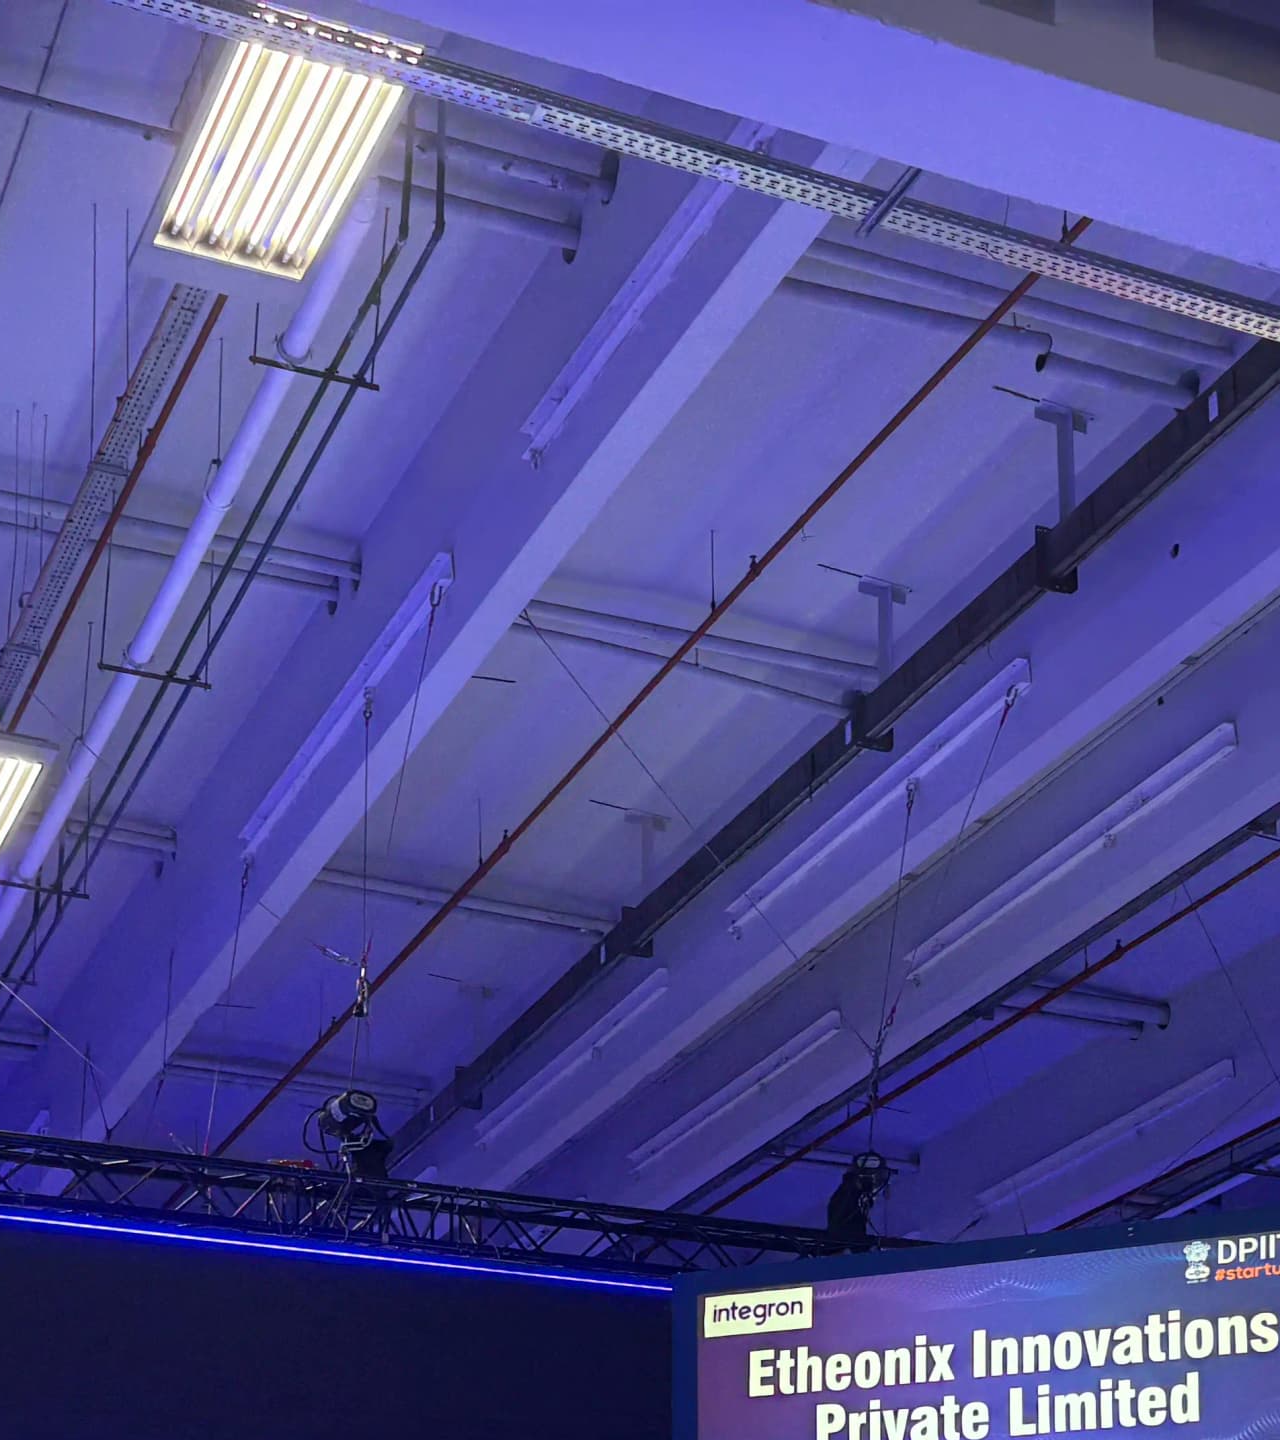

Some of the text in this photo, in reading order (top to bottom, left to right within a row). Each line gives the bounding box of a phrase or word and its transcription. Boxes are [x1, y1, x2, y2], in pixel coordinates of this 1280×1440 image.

[713, 1300, 803, 1326] integron
[748, 1309, 1279, 1398] Etheonix Innovations
[1009, 1371, 1200, 1437] Limited
